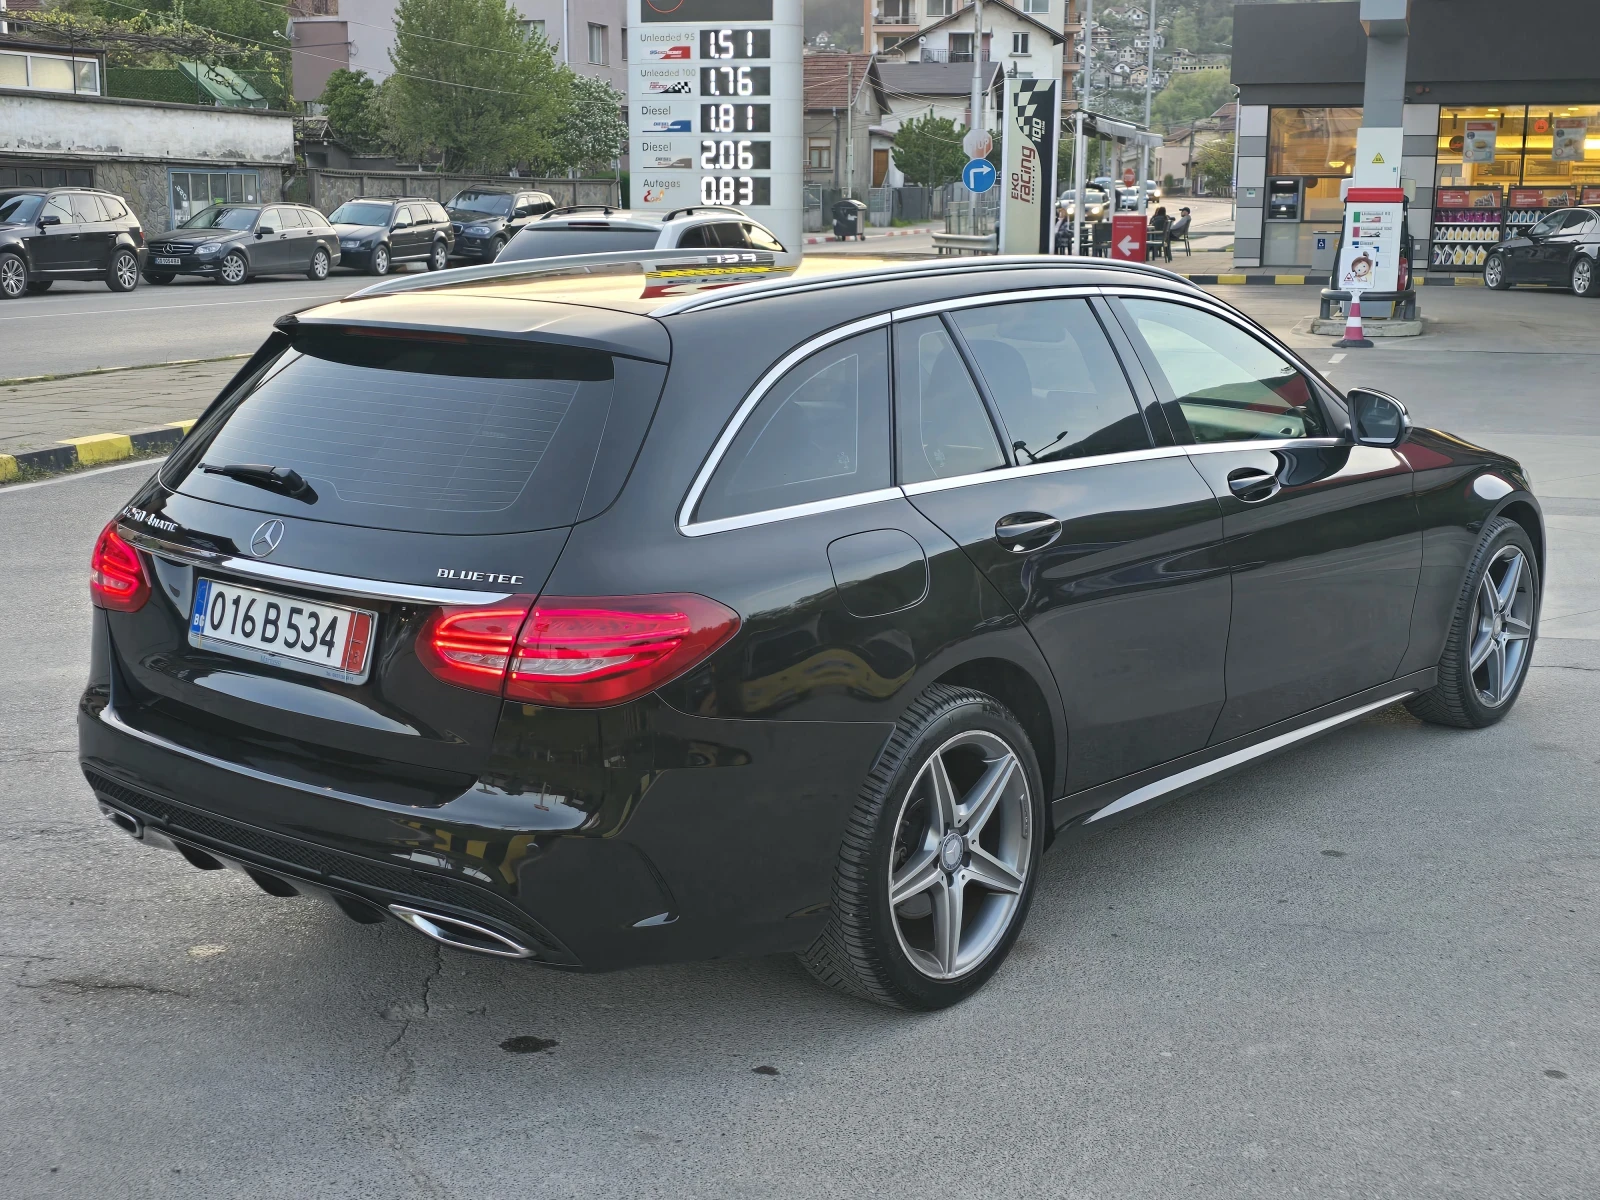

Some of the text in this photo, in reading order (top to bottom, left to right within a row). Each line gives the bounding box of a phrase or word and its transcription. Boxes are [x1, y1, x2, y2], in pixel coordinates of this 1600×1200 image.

[640, 33, 695, 42] Unleaded 95
[709, 29, 753, 59] 1.51
[640, 68, 696, 77] Unleaded 100
[709, 66, 753, 96] 1.76
[641, 105, 671, 115] Diesel
[709, 104, 753, 133] 1.81
[1031, 117, 1042, 142] 100
[642, 141, 672, 152] Diesel
[700, 140, 754, 170] 2.06
[642, 178, 681, 190] Autogas
[1011, 172, 1020, 200] EKO
[1019, 145, 1036, 204] racing
[700, 176, 754, 206] 0.83
[437, 568, 524, 585] BLUETEC
[193, 613, 205, 627] BG
